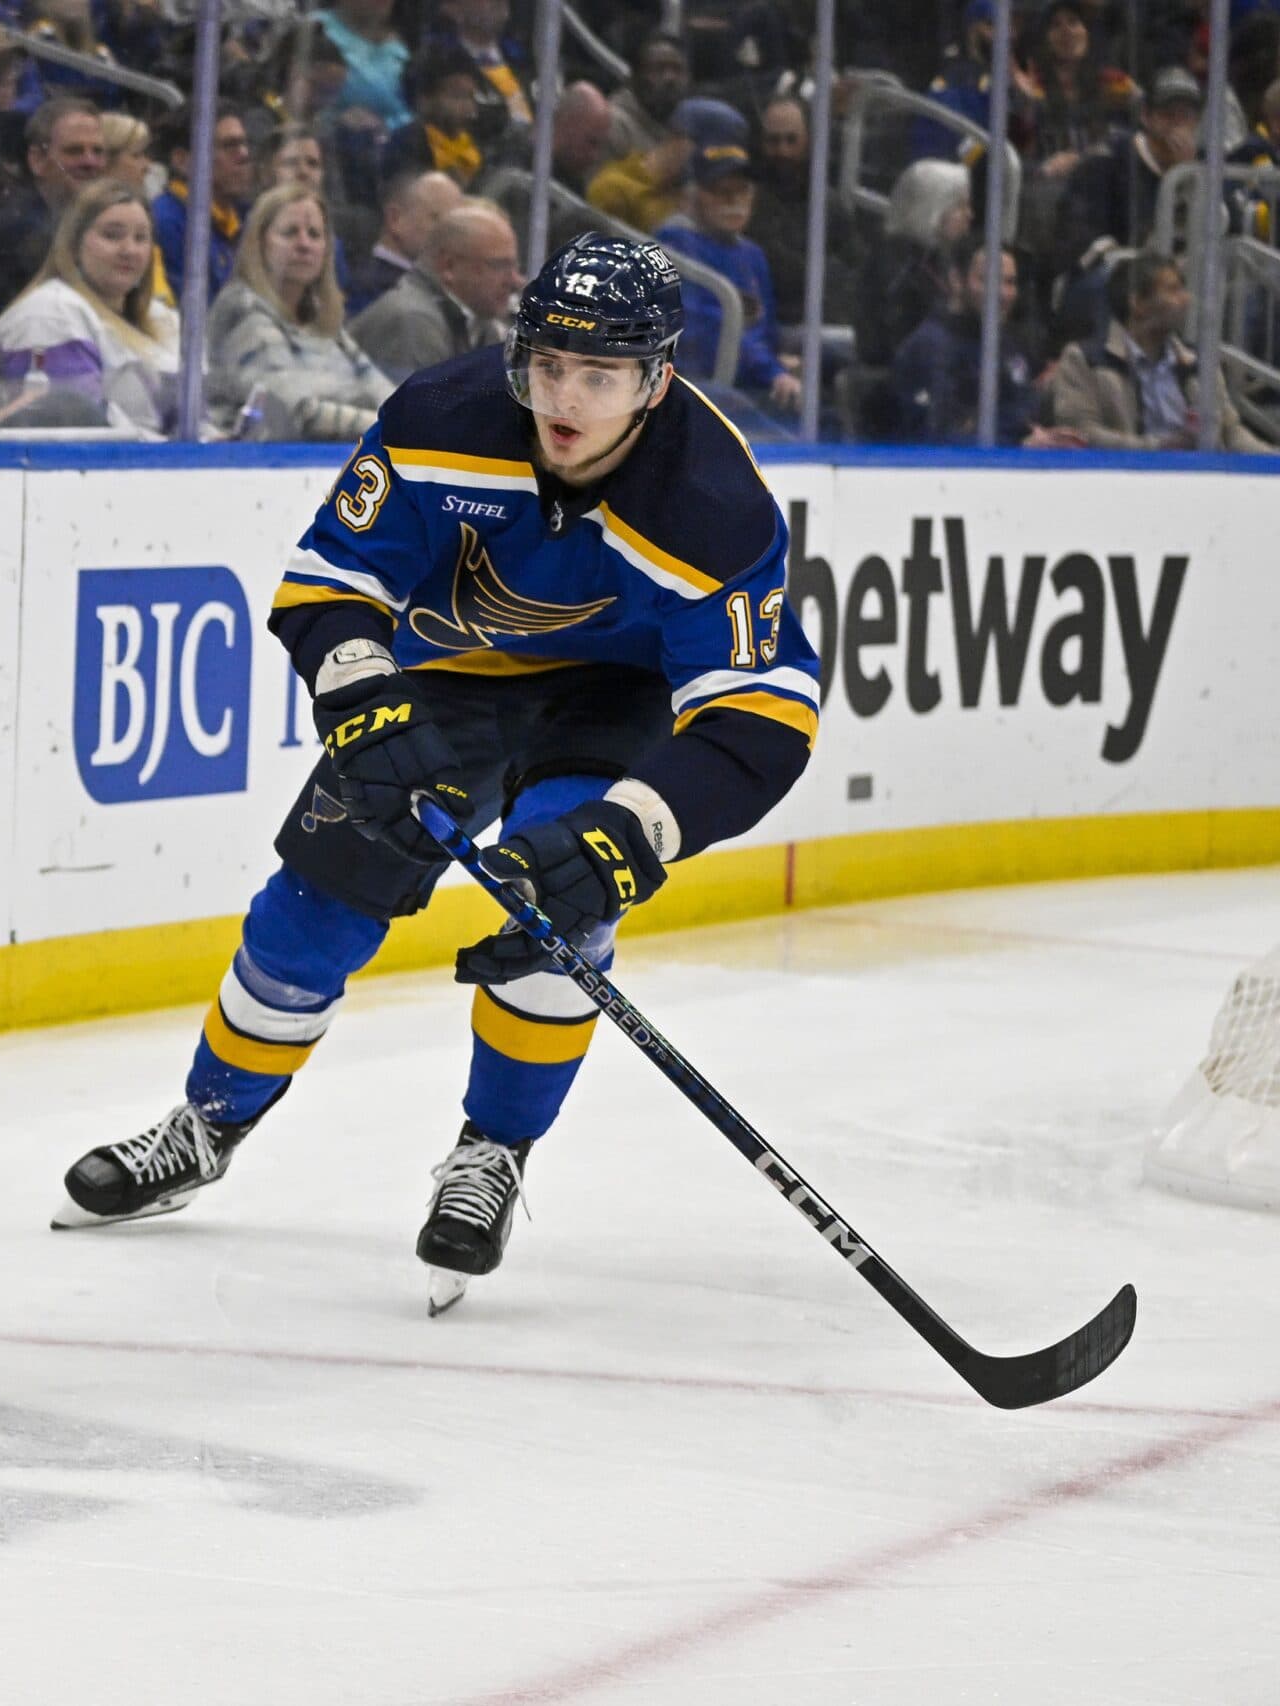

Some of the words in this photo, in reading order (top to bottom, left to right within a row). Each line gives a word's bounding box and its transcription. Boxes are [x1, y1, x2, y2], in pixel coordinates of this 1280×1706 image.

[546, 313, 596, 330] CCM
[565, 272, 598, 297] 13
[327, 442, 391, 533] 3
[441, 495, 508, 520] STIFEL
[726, 587, 784, 667] 13
[789, 500, 1190, 764] betway
[90, 601, 236, 786] BJC
[324, 702, 413, 759] CCM
[582, 827, 637, 910] CC
[540, 935, 652, 1047] JETSPEED
[754, 1150, 871, 1268] CCM
